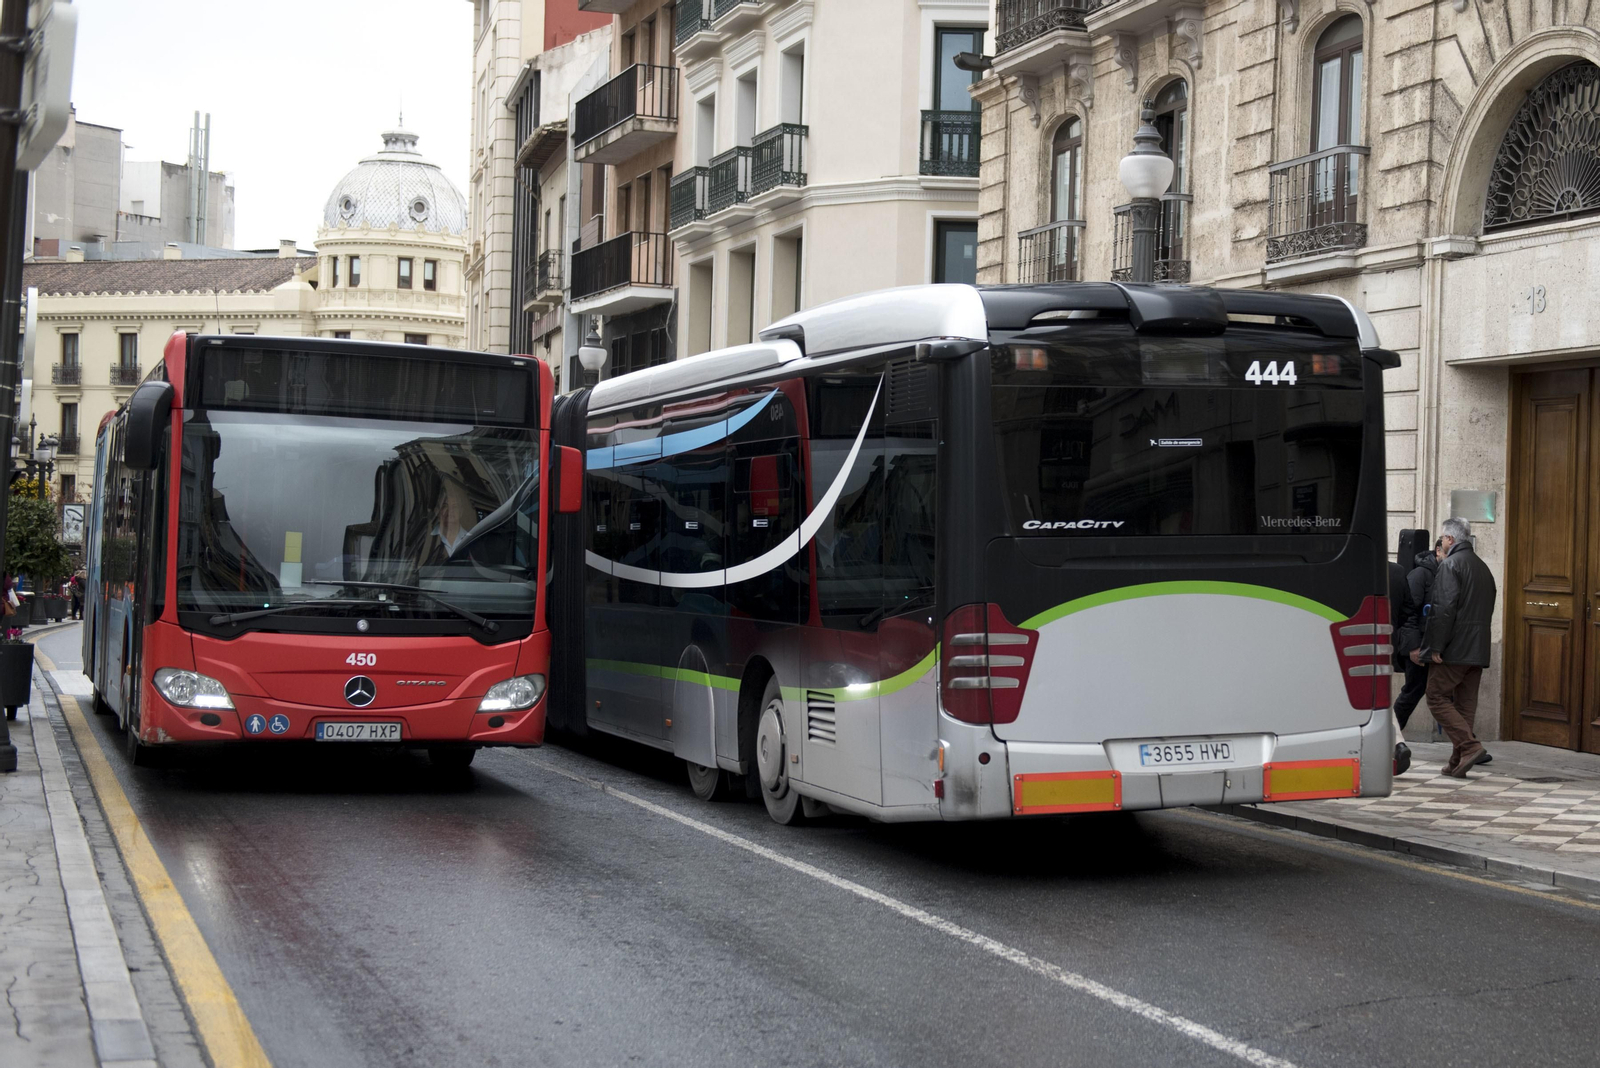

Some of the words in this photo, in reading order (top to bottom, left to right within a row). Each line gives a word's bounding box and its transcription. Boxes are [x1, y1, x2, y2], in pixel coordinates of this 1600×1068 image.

[1526, 285, 1547, 316] 13
[1244, 360, 1298, 386] 444
[1260, 515, 1342, 528] Mercedes-Benz
[345, 652, 377, 667] 450
[325, 724, 365, 738] 0407
[369, 724, 398, 738] HXP
[1152, 744, 1195, 763] 3655
[1199, 743, 1231, 760] HVD
